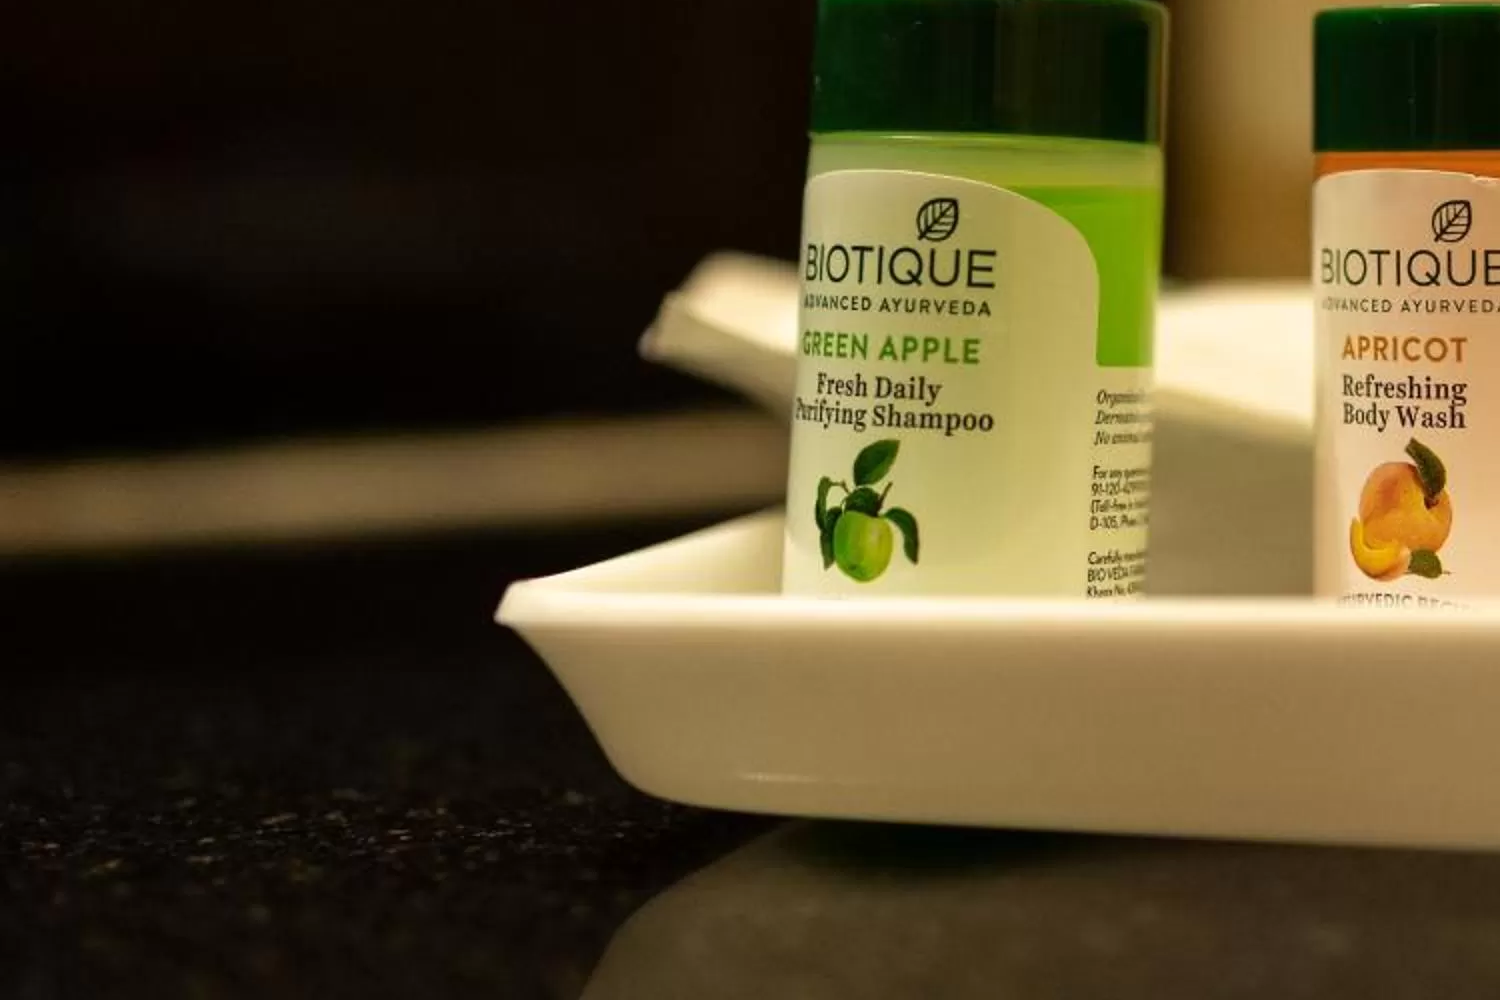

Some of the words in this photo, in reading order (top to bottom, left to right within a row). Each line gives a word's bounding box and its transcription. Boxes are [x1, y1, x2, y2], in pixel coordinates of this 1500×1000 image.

[805, 243, 997, 289] BIOTIQUE
[878, 297, 992, 317] AYURVEDA
[802, 328, 869, 360] GREEN
[878, 334, 980, 364] APPLE
[1341, 335, 1468, 363] APRICOT
[817, 371, 868, 398] Fresh
[874, 376, 943, 407] Daily
[1341, 374, 1468, 405] Refreshing
[871, 403, 994, 436] Shampoo
[1343, 402, 1391, 432] Body
[1396, 404, 1468, 429] Wash
